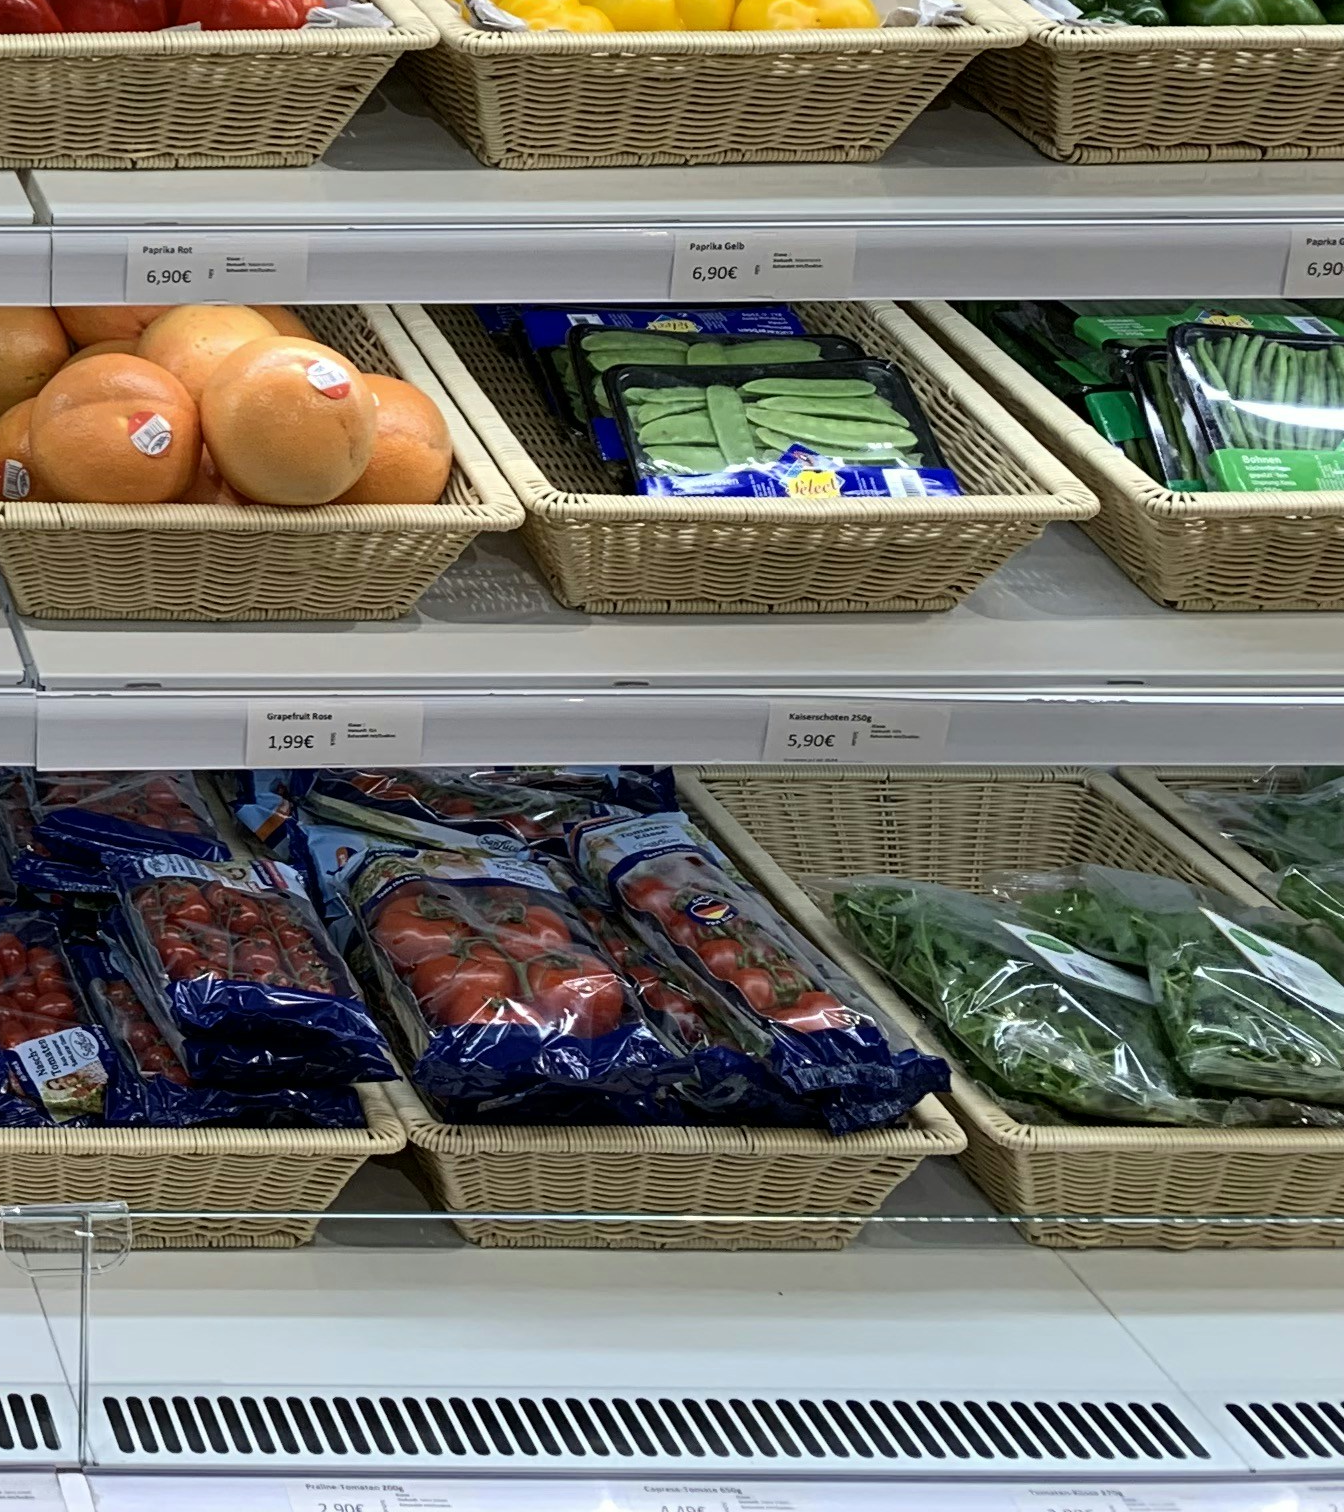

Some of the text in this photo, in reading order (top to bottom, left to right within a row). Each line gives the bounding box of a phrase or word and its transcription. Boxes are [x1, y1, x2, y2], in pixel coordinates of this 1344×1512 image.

[143, 246, 192, 255] Paprika Rot
[690, 242, 744, 252] Paprika Gelb
[693, 266, 738, 281] 6,90€
[1307, 262, 1344, 277] 6,90
[147, 270, 191, 285] 6,90€
[1241, 454, 1282, 464] Bohnen
[794, 478, 836, 496] Select
[267, 712, 310, 721] Grapefruit
[789, 713, 874, 723] Kaiserschoten 250g
[269, 735, 314, 750] 1,99€
[788, 734, 835, 748] 5,90€
[481, 838, 520, 852] SanLuca
[37, 1038, 62, 1076] Tomaten
[318, 1503, 363, 1512] 290€
